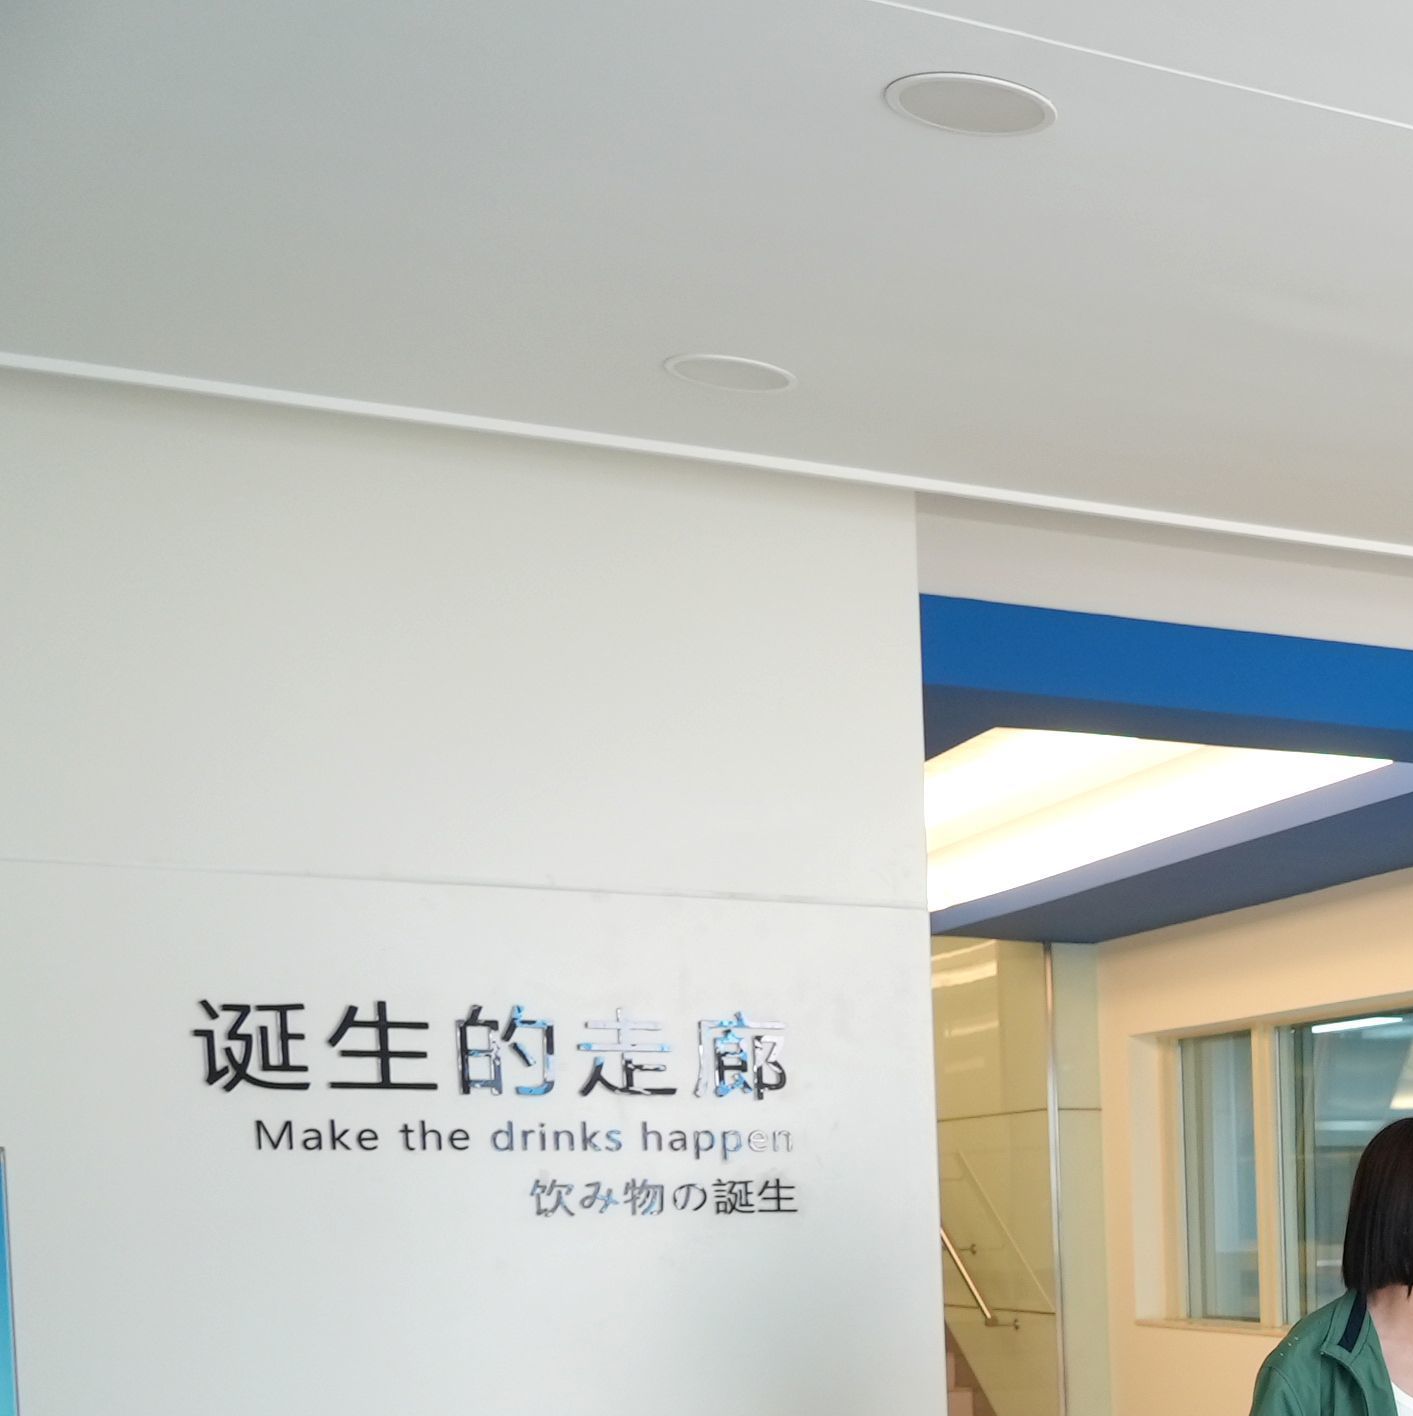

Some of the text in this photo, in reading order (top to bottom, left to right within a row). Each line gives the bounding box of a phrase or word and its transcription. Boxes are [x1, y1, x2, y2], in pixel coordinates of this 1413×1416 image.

[192, 998, 786, 1101] 诞生的走廊
[254, 1118, 794, 1161] Make the drinks happen
